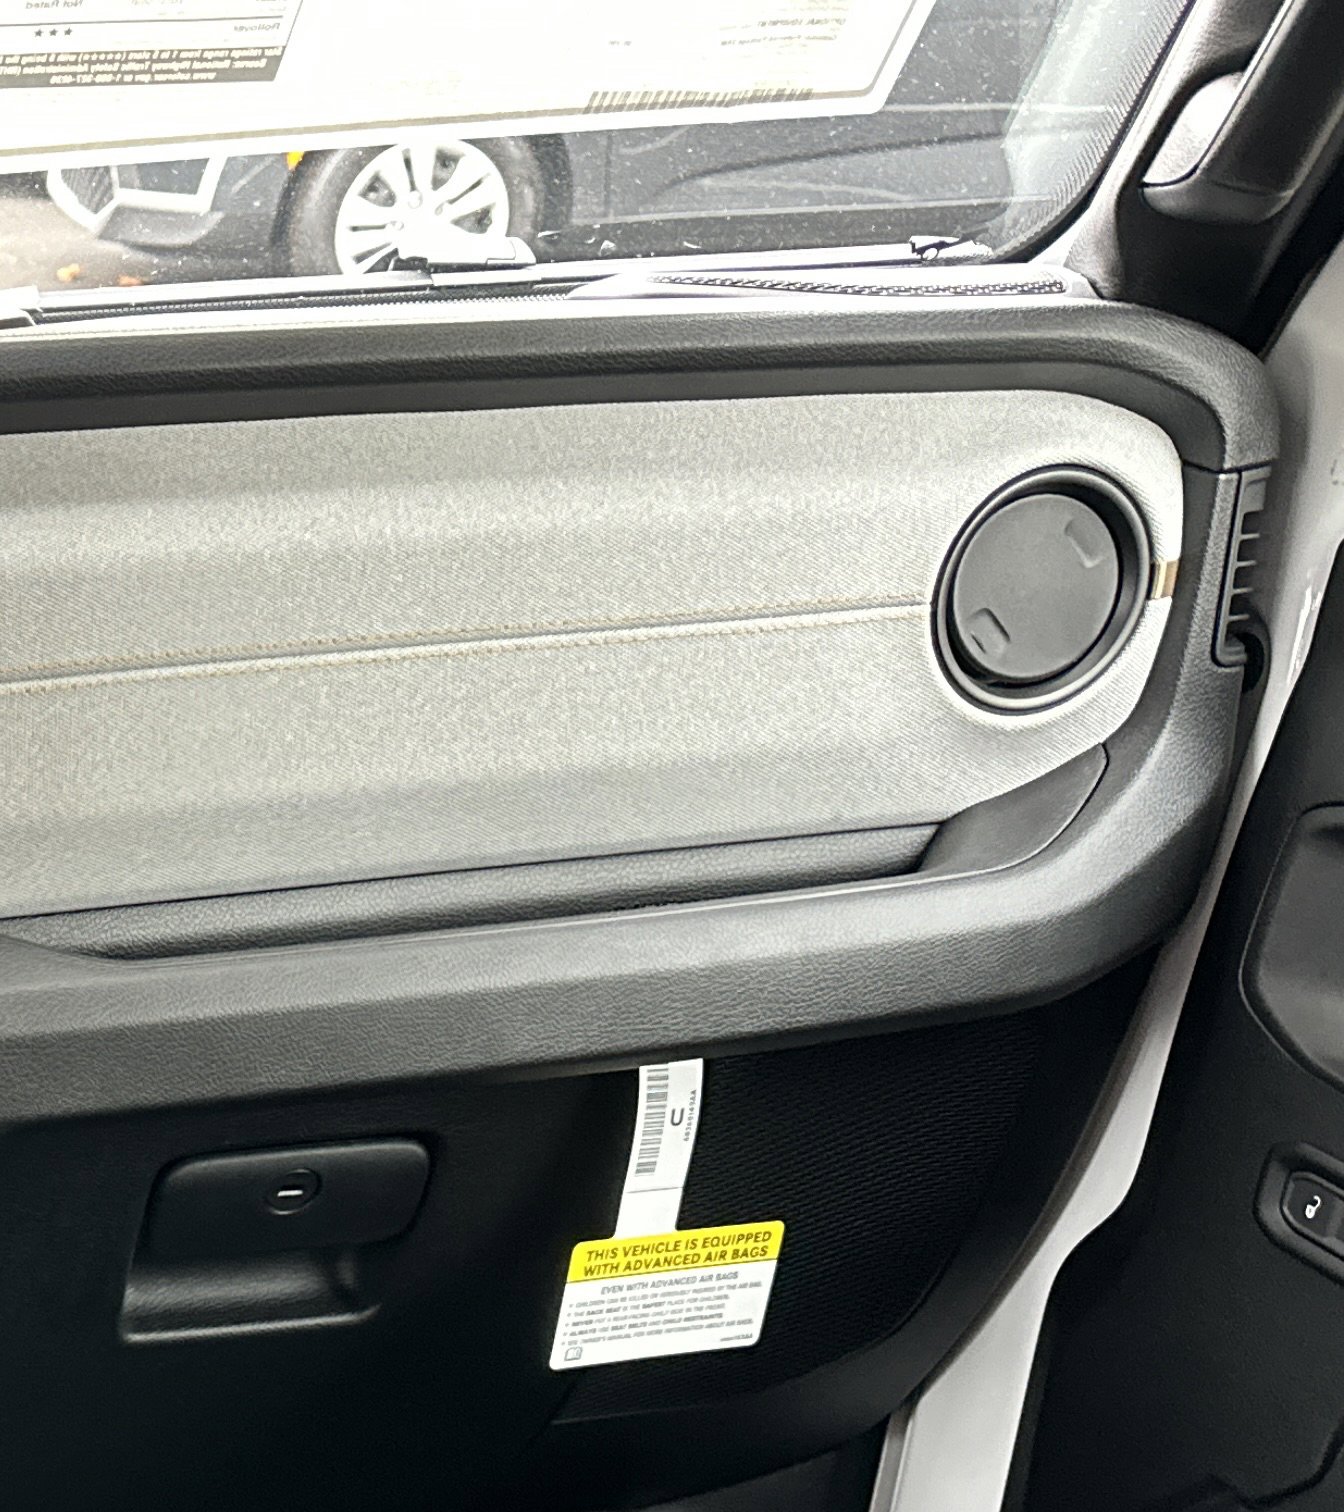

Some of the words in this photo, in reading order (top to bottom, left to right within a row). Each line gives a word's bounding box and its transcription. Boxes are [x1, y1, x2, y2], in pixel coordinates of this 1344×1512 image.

[671, 1108, 685, 1126] U
[587, 1247, 619, 1262] THIS
[623, 1240, 681, 1256] VEHICLE
[685, 1238, 699, 1250] IS
[702, 1231, 773, 1250] EQUIPPED
[583, 1263, 620, 1277] WITH
[623, 1254, 701, 1272] ADVANCED
[704, 1250, 729, 1263] AIR
[731, 1245, 769, 1260] BAGS
[626, 1282, 648, 1291] WITH
[650, 1275, 697, 1289] ADVANCED
